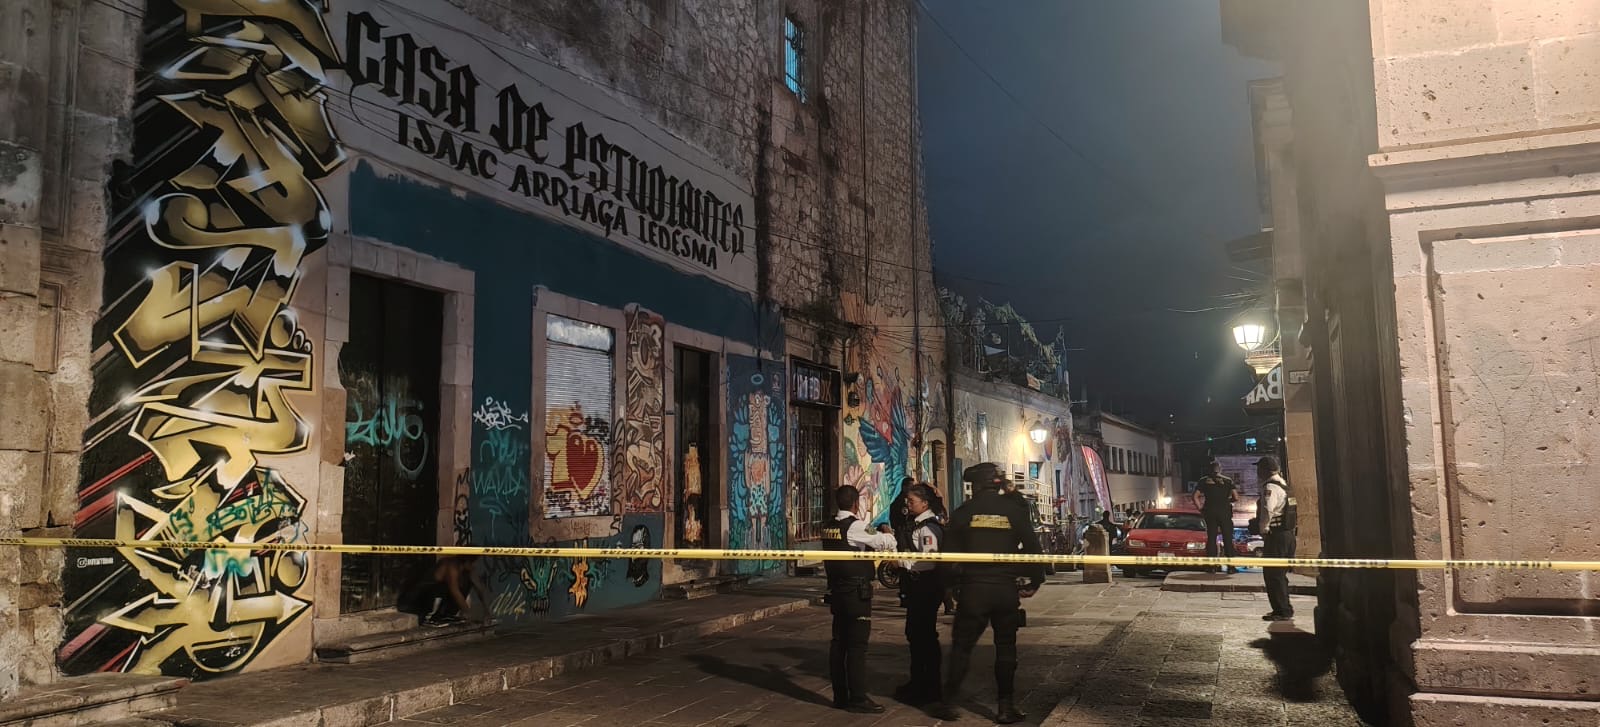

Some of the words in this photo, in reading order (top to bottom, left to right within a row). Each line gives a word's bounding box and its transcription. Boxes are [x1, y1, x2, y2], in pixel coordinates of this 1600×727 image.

[347, 11, 480, 133] CASA
[397, 111, 498, 179] ISAAC
[509, 165, 628, 237] ARRIAGA
[638, 215, 718, 270] LEDESMA
